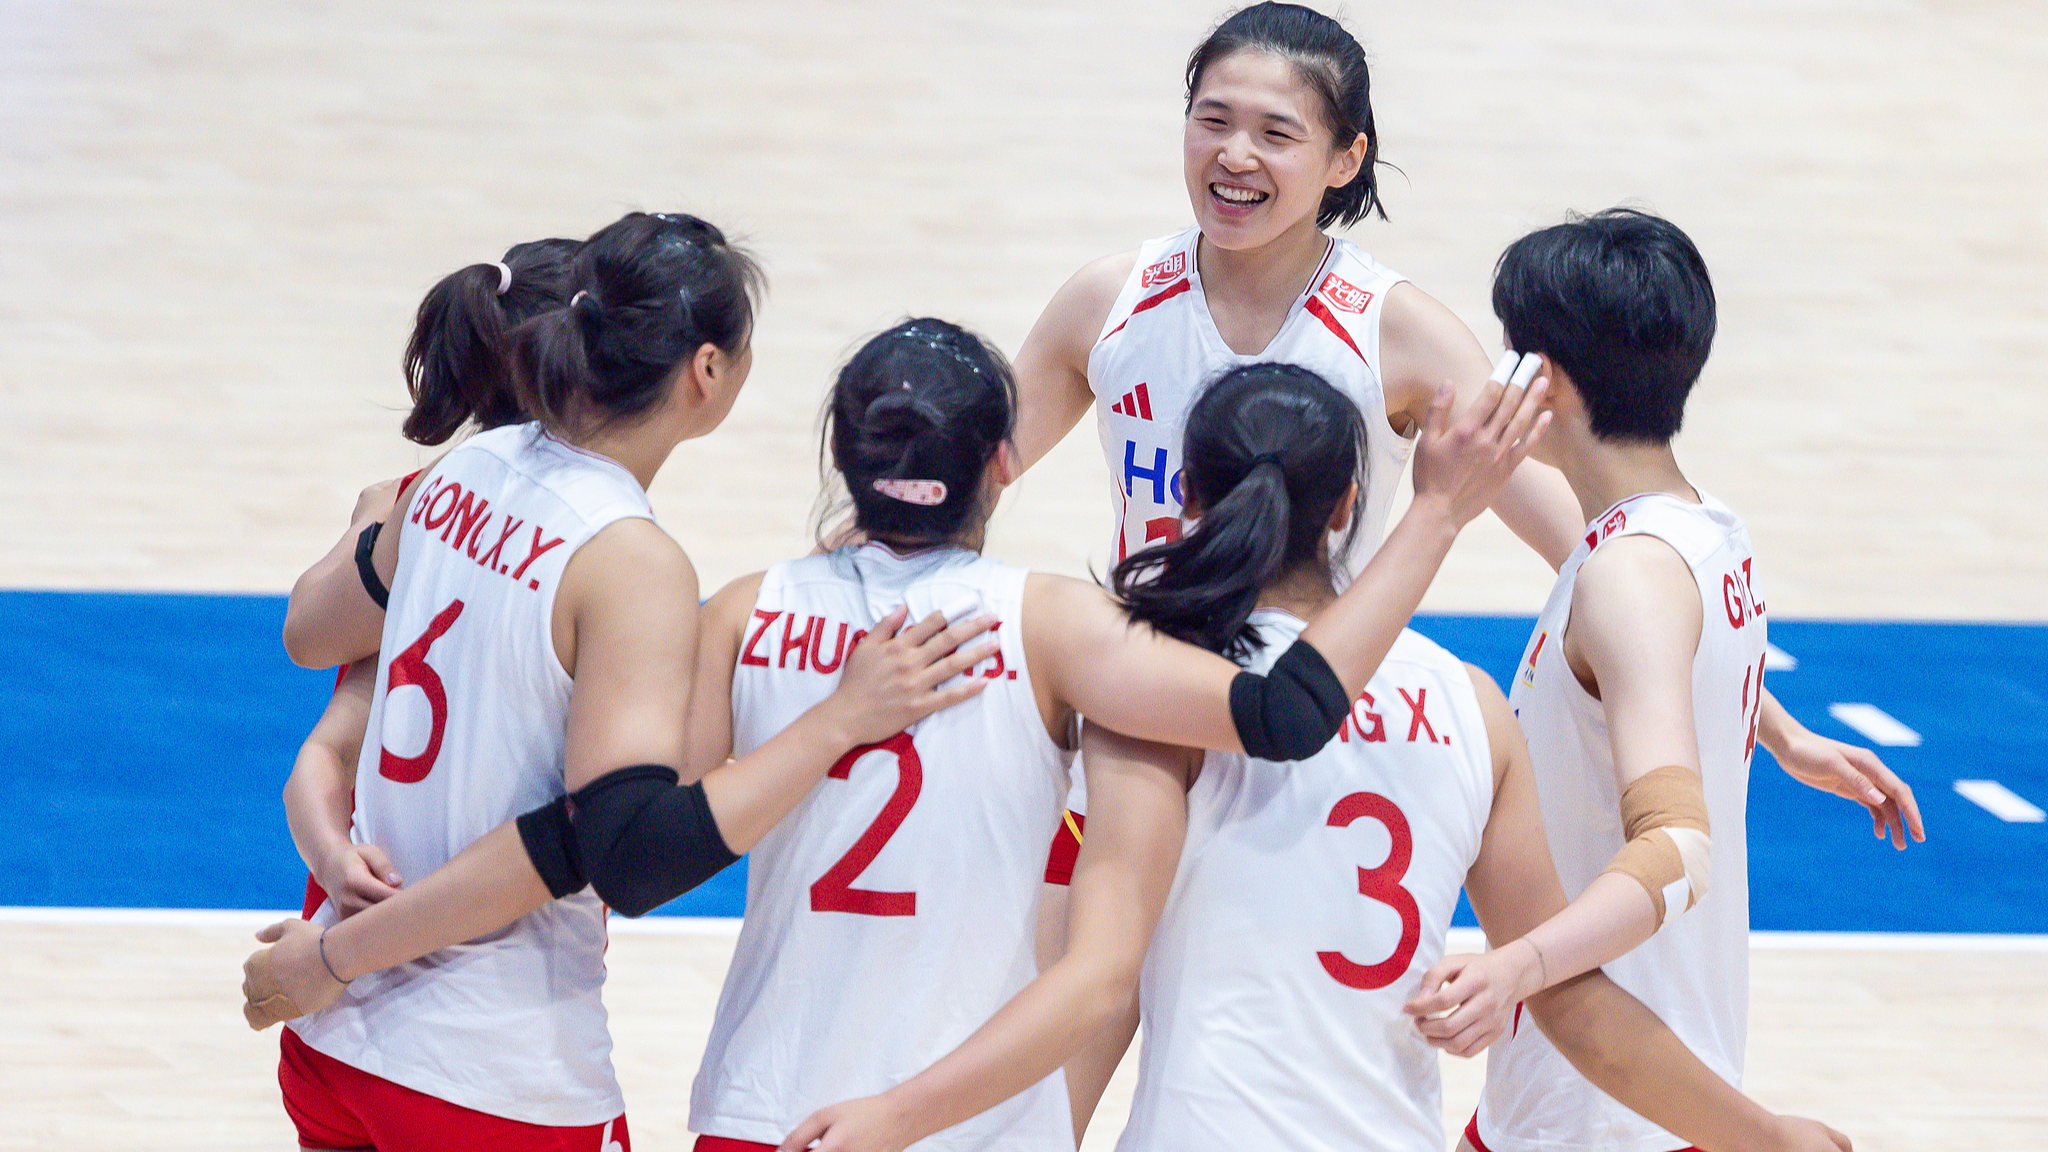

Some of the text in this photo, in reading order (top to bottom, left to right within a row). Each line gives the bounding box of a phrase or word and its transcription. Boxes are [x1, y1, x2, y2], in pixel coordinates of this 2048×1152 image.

[1143, 252, 1184, 286] 光明
[1321, 274, 1372, 312] 光明
[378, 598, 465, 784] 6
[1396, 687, 1451, 746] X.
[809, 731, 923, 917] 2
[1316, 791, 1421, 991] 3
